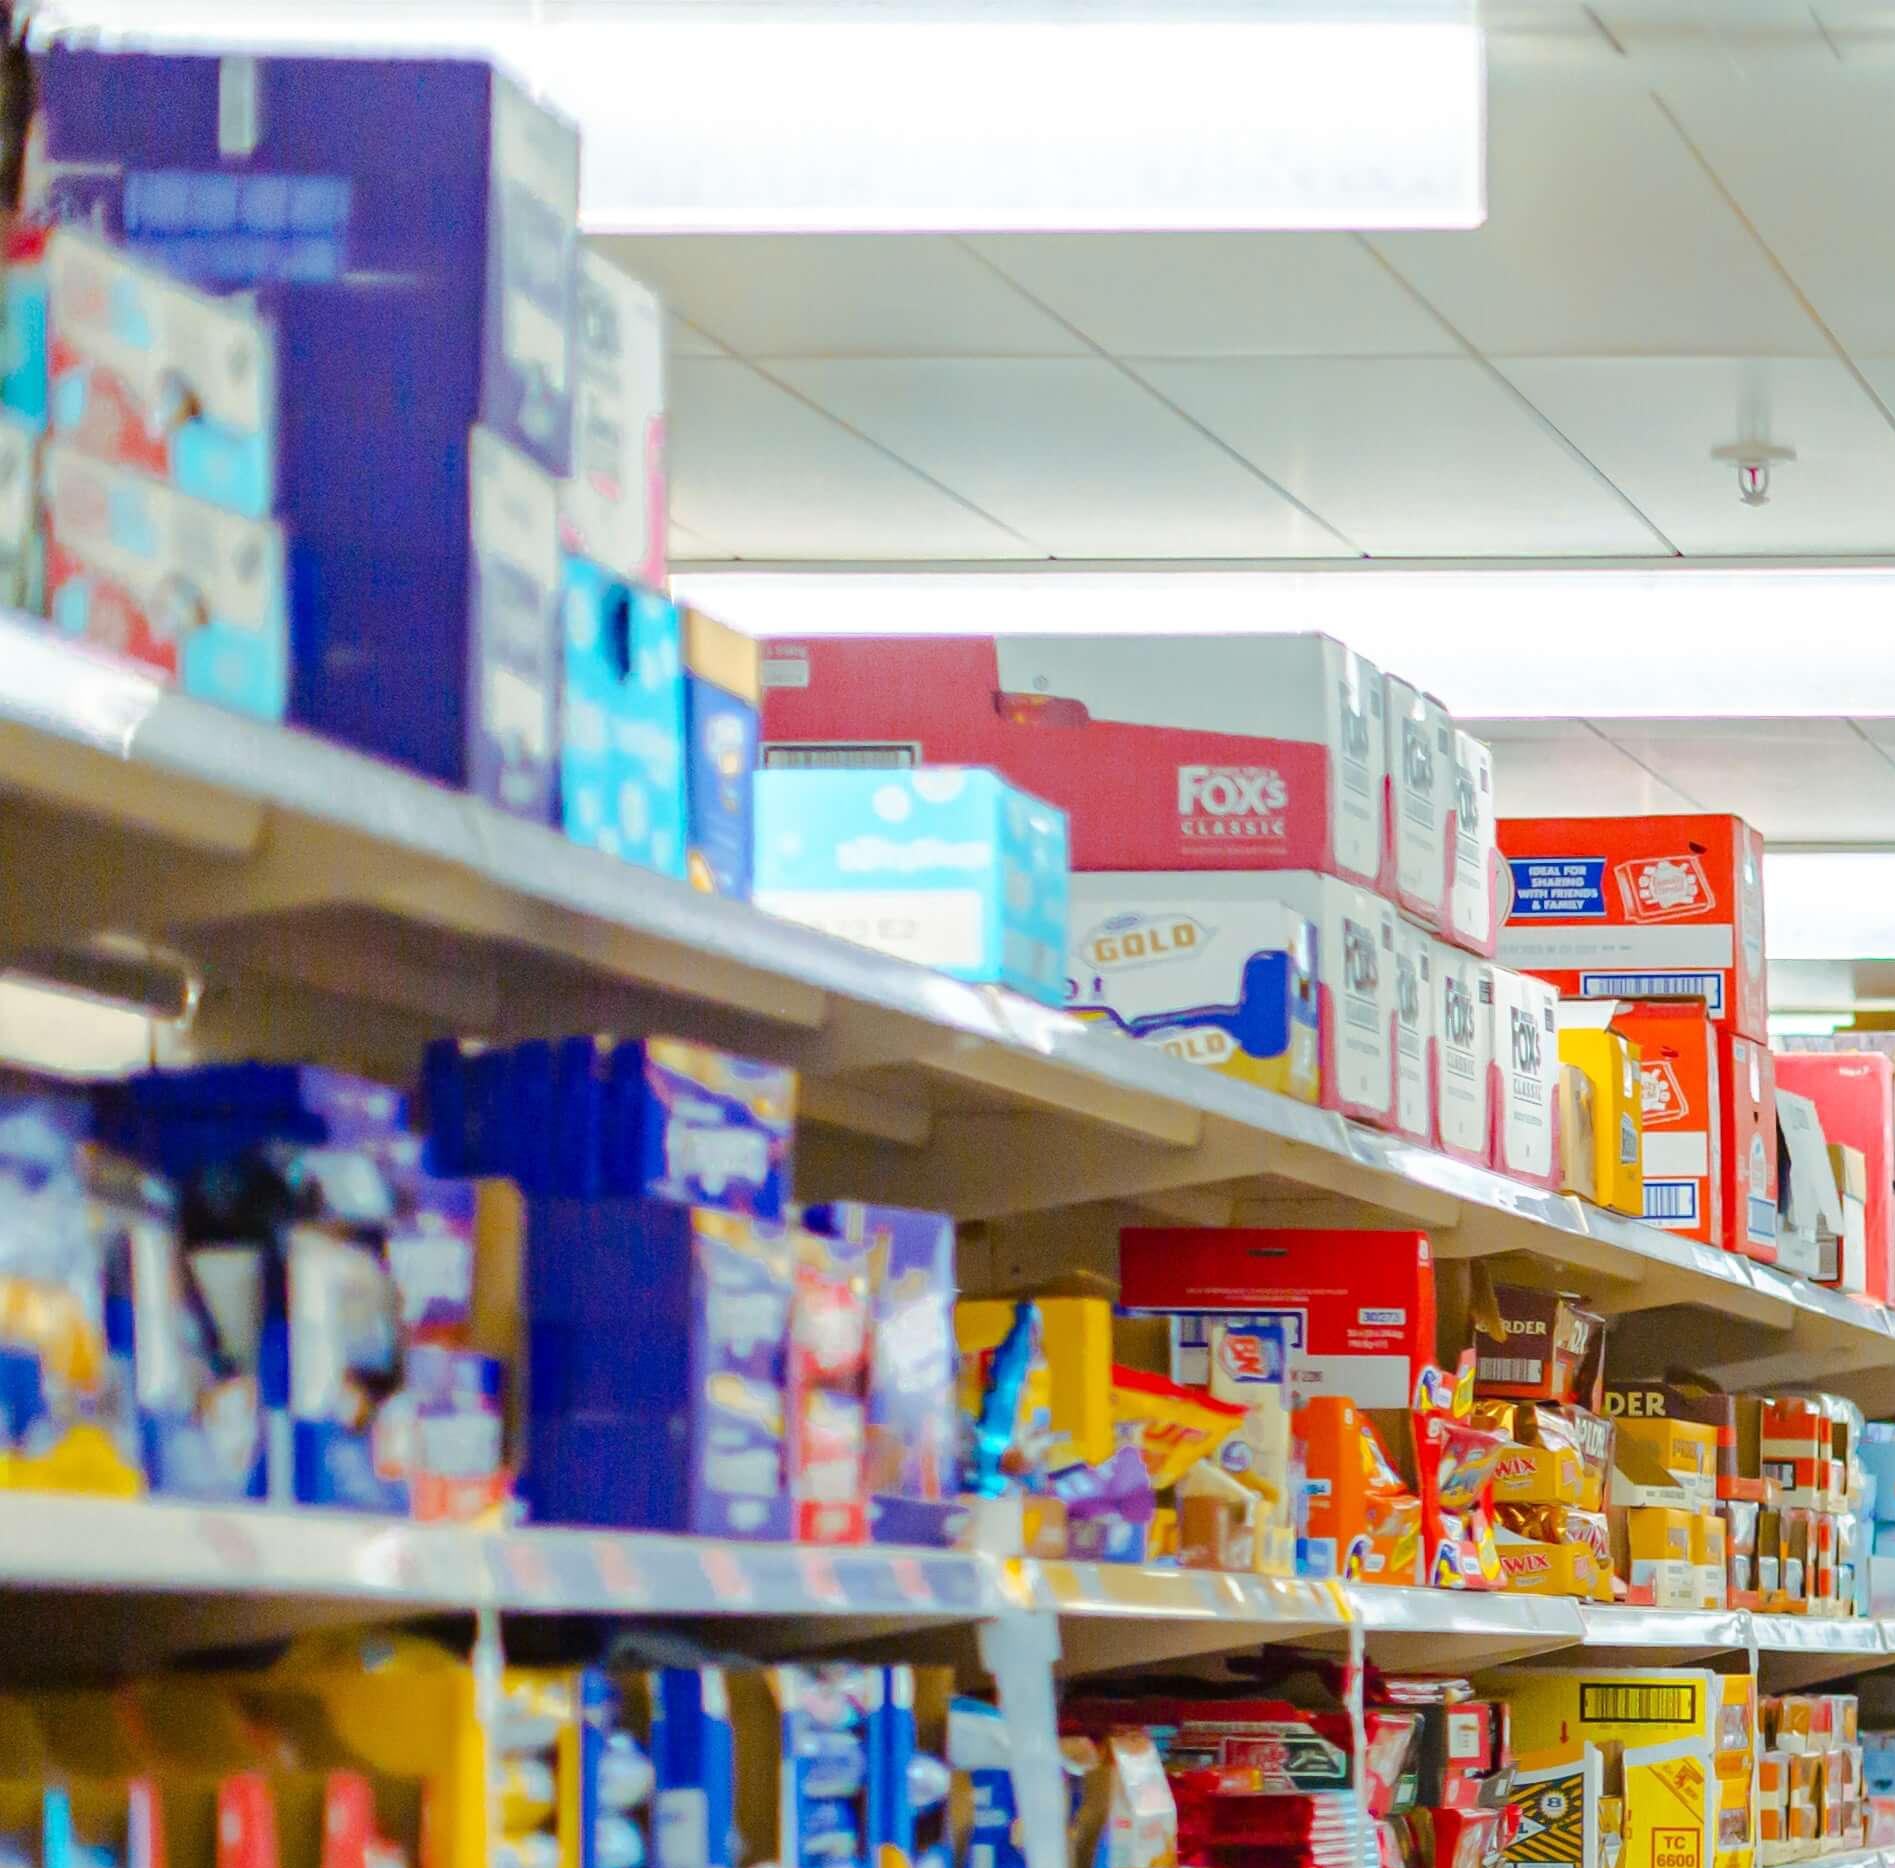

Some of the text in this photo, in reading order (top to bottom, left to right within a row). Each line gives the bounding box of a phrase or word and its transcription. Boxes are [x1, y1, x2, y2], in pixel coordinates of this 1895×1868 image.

[1180, 821, 1286, 837] CLASSIC
[1528, 865, 1588, 877] IDEAL FOR
[1530, 877, 1585, 888] SHARING
[1517, 887, 1599, 899] WITH FRIENDS
[1543, 899, 1585, 911] FAMILY
[1093, 923, 1196, 962] GOLD
[1163, 1032, 1227, 1059] OLD
[1606, 1391, 1667, 1417] DER
[1663, 1835, 1686, 1850] TC
[1656, 1854, 1695, 1868] 6600
